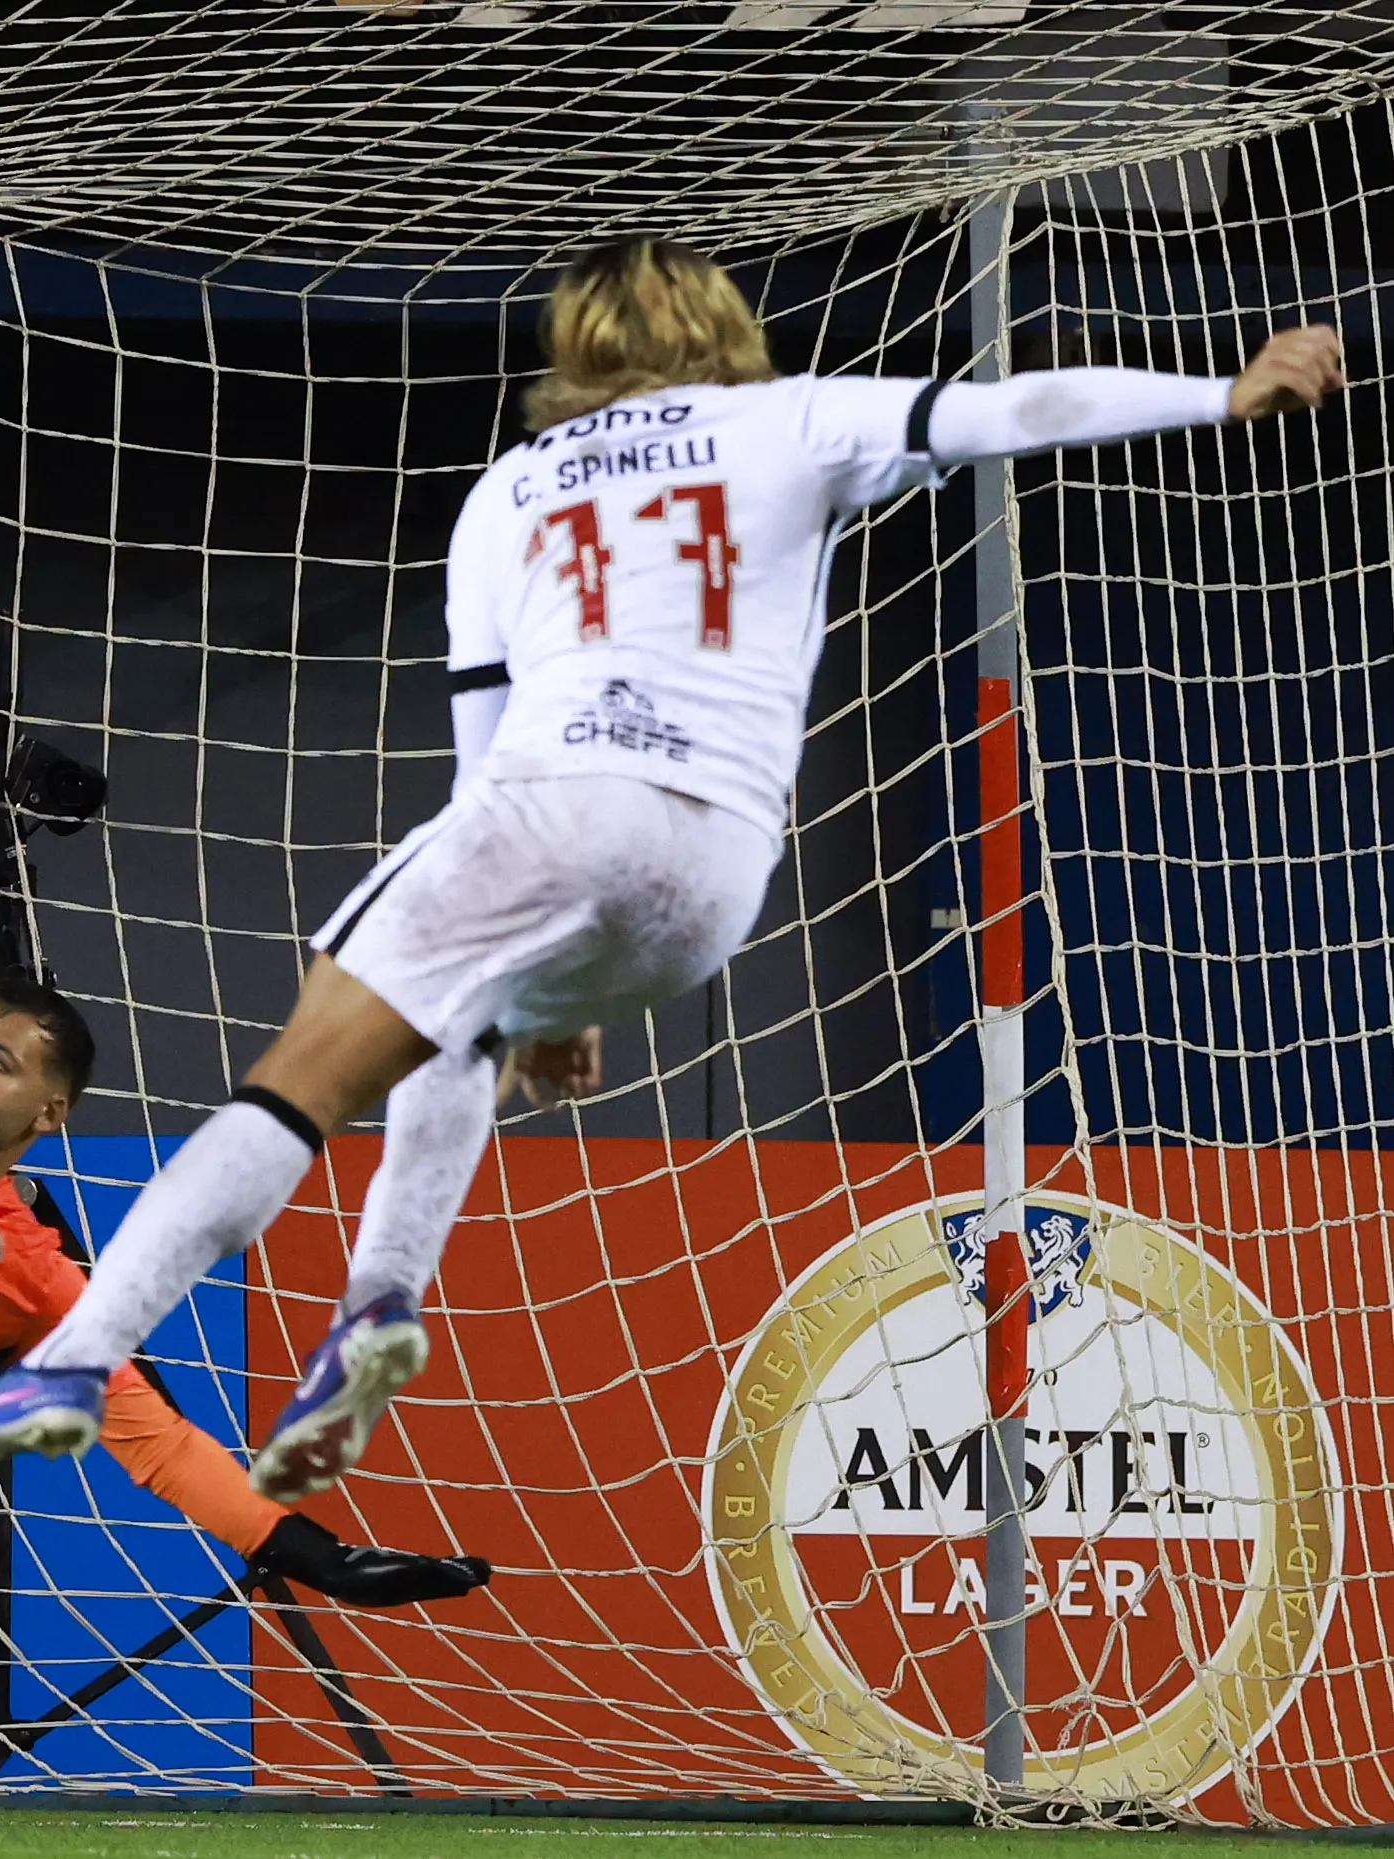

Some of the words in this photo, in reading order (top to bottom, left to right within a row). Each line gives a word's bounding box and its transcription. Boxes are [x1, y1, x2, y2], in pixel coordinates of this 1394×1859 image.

[512, 475, 542, 508] C.
[557, 436, 716, 491] SPINELLI
[736, 1240, 903, 1444] PREMIUM
[1140, 1243, 1237, 1338] BIER
[1244, 1373, 1320, 1677] TRADITION
